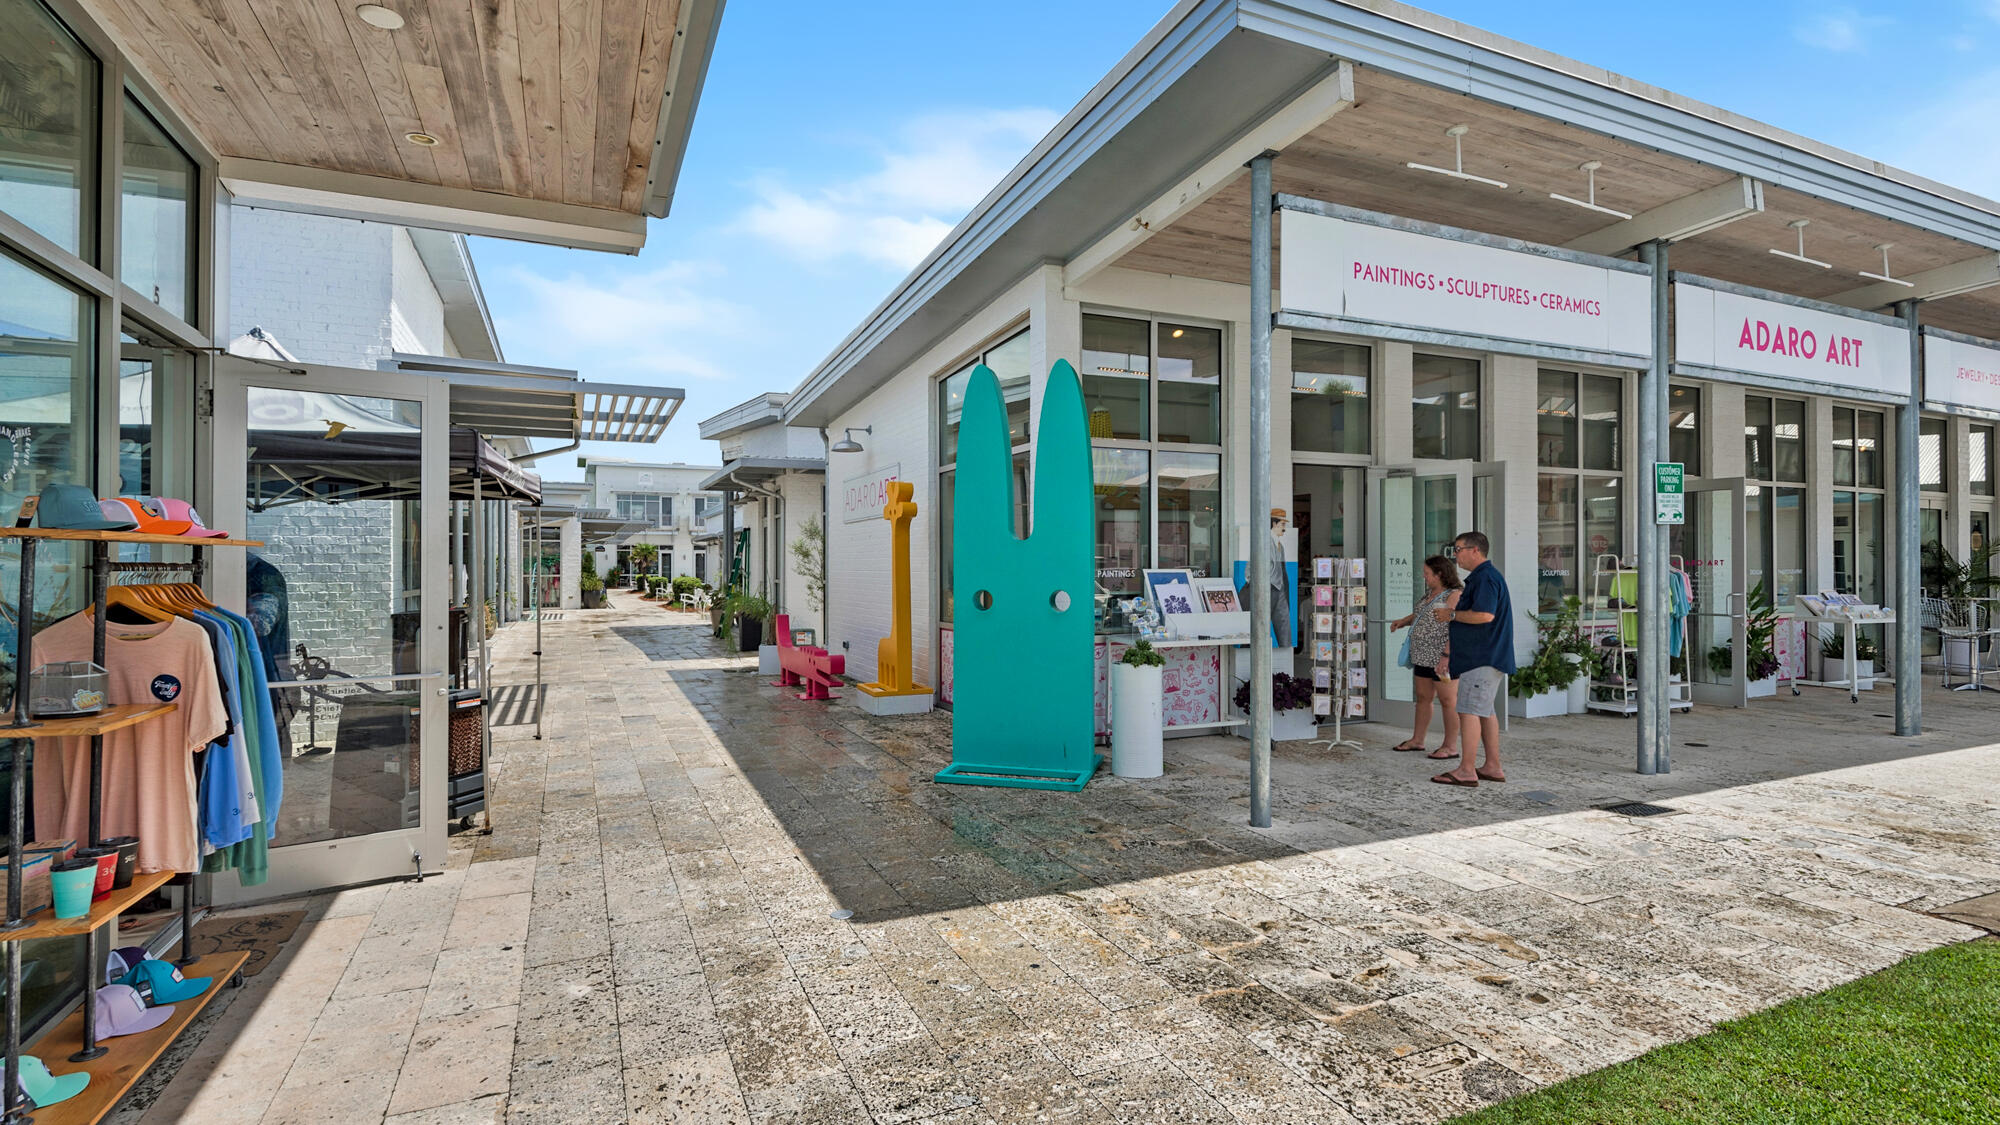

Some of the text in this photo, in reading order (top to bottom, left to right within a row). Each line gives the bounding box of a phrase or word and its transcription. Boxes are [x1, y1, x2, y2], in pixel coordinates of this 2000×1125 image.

[1353, 261, 1601, 317] PAINTINGS SCULPTURES CERAMICS
[1738, 317, 1863, 368] ADARO ART
[1956, 367, 1985, 384] JEWELRY
[0, 425, 20, 484] ANDLEBARS
[1658, 466, 1681, 476] CUSTOMER
[1660, 476, 1680, 484] PARKING
[1664, 485, 1676, 493] ONLY
[1708, 559, 1725, 567] ART
[1097, 569, 1136, 578] PAINTINGS
